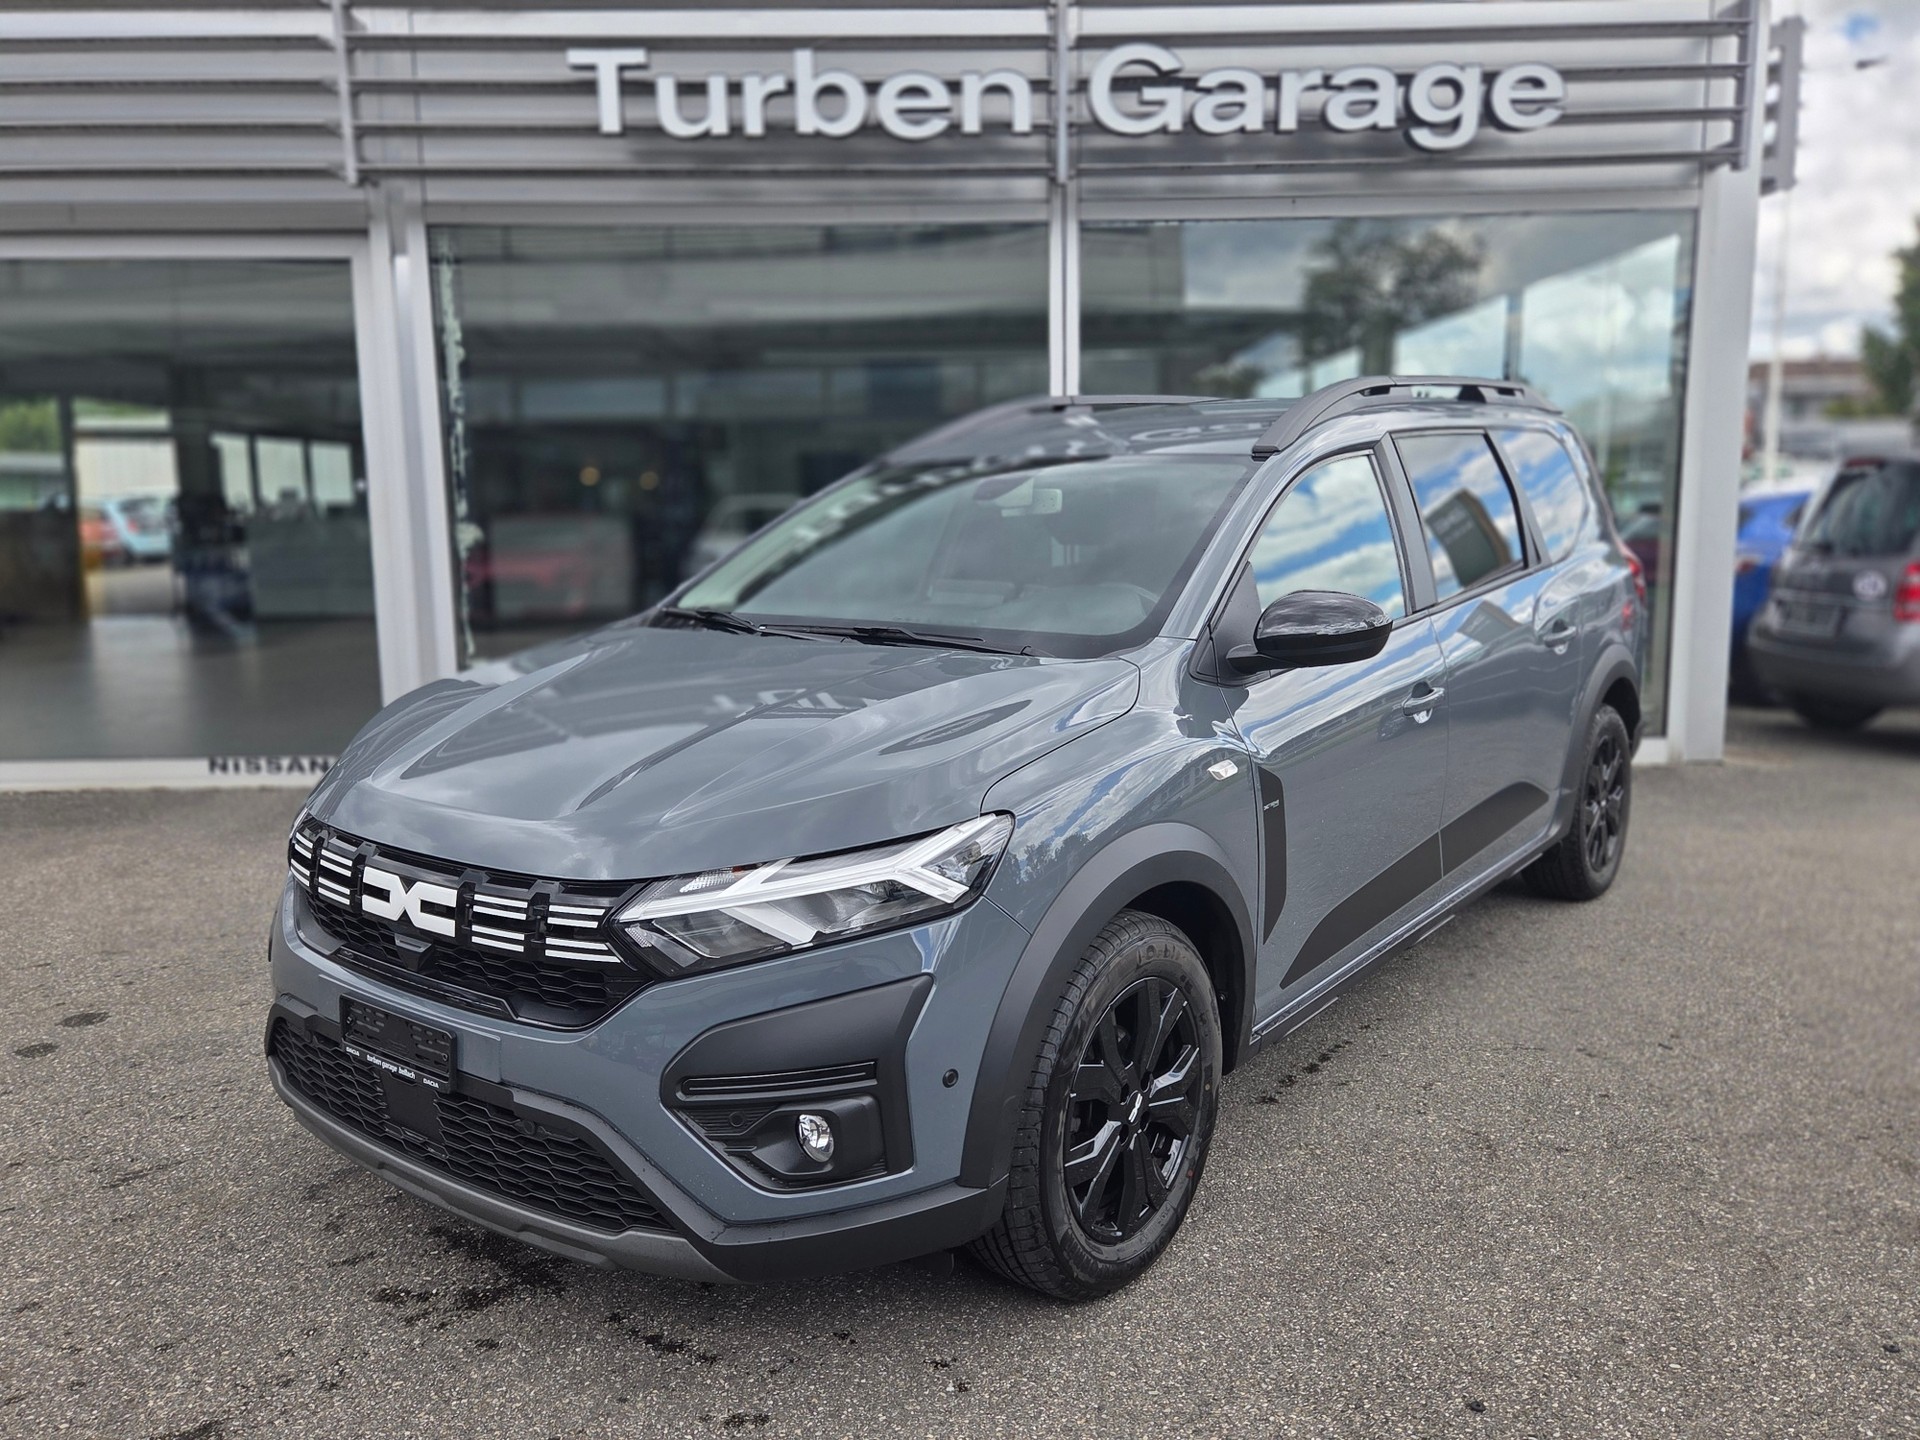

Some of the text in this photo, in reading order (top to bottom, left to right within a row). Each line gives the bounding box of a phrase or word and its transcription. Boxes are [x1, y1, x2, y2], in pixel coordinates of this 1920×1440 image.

[565, 42, 1567, 151] Turben Garage
[207, 755, 329, 774] NISSAN
